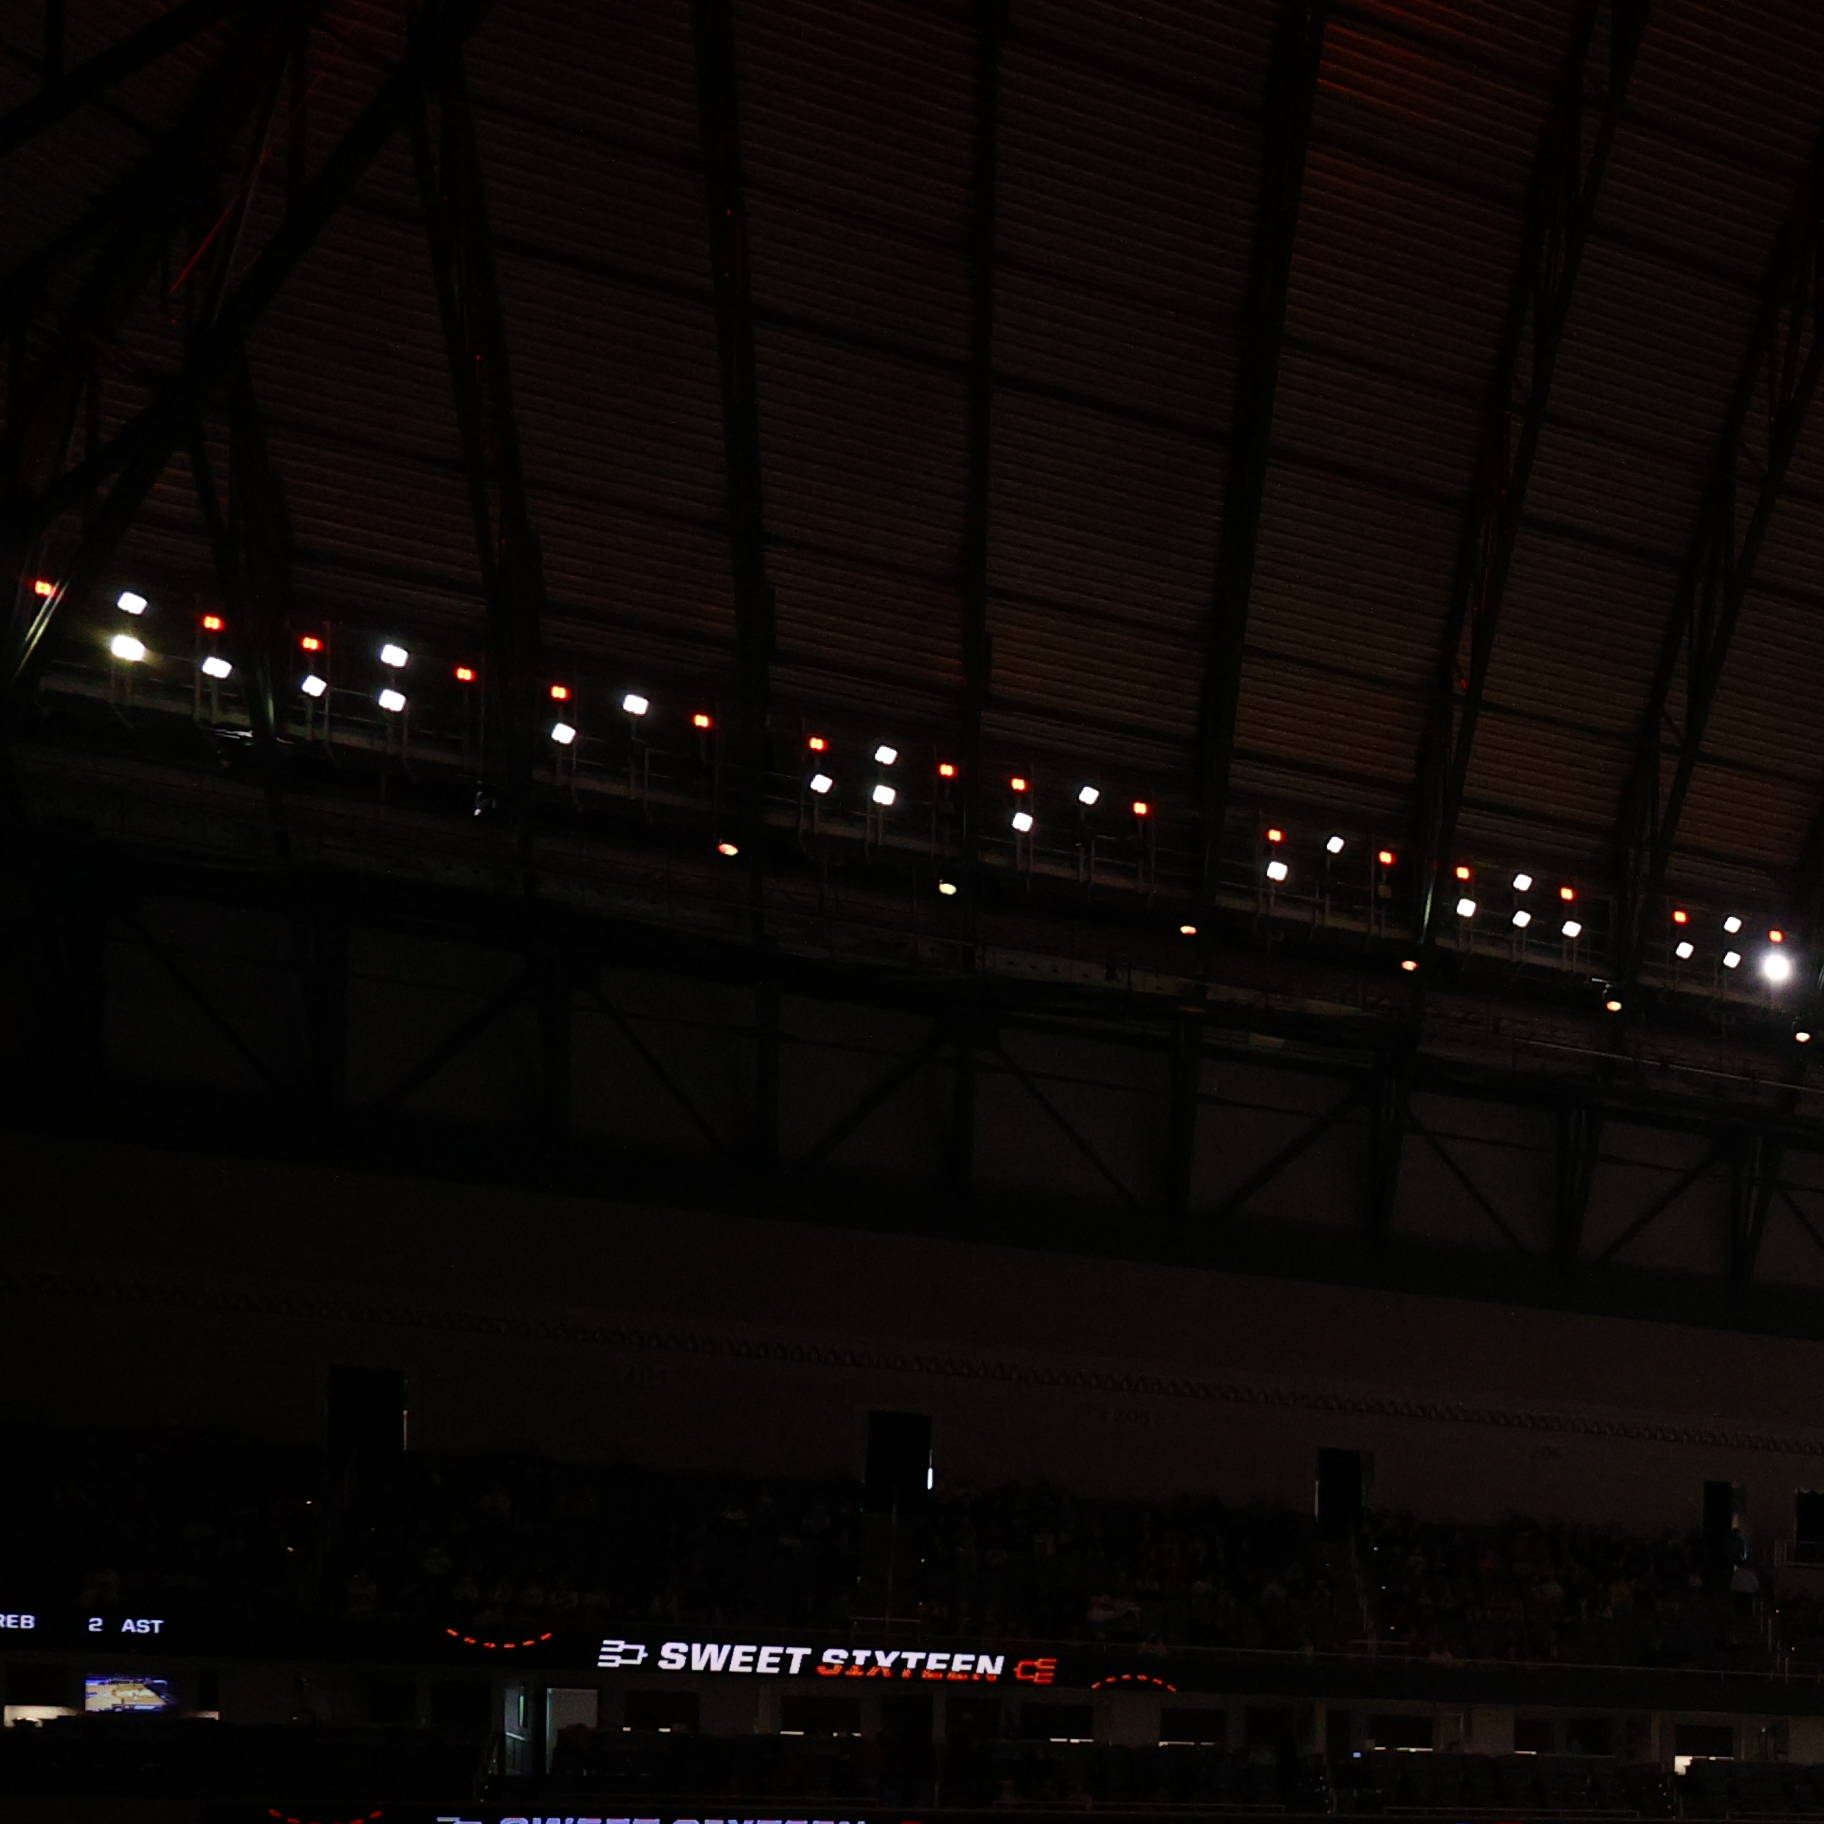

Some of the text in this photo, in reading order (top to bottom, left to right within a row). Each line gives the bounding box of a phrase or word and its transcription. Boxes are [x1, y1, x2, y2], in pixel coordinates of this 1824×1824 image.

[89, 1618, 102, 1631] 2
[122, 1619, 163, 1633] AST
[656, 1641, 1005, 1683] SWEET SIXTEEN
